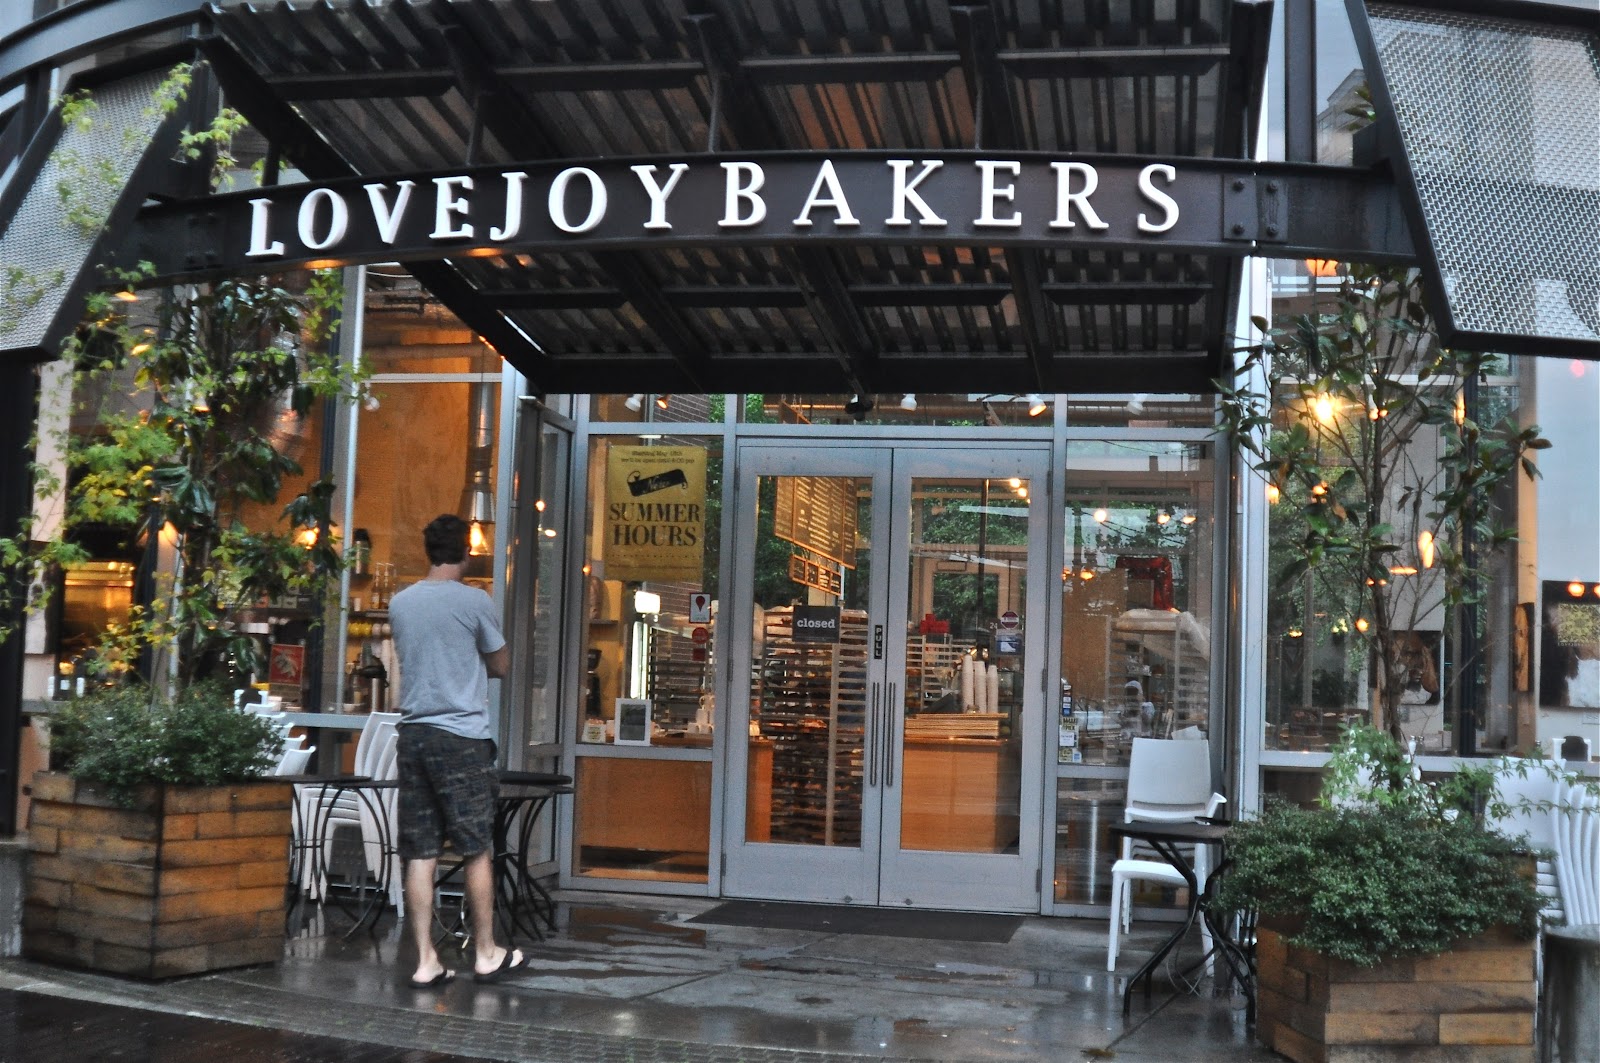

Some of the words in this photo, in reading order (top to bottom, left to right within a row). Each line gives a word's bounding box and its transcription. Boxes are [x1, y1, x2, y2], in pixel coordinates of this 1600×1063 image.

[245, 163, 689, 257] LOVEJOY
[717, 159, 1180, 233] BAKERS
[609, 502, 701, 523] SUMMER
[612, 524, 698, 547] HOURS
[796, 617, 836, 629] closed
